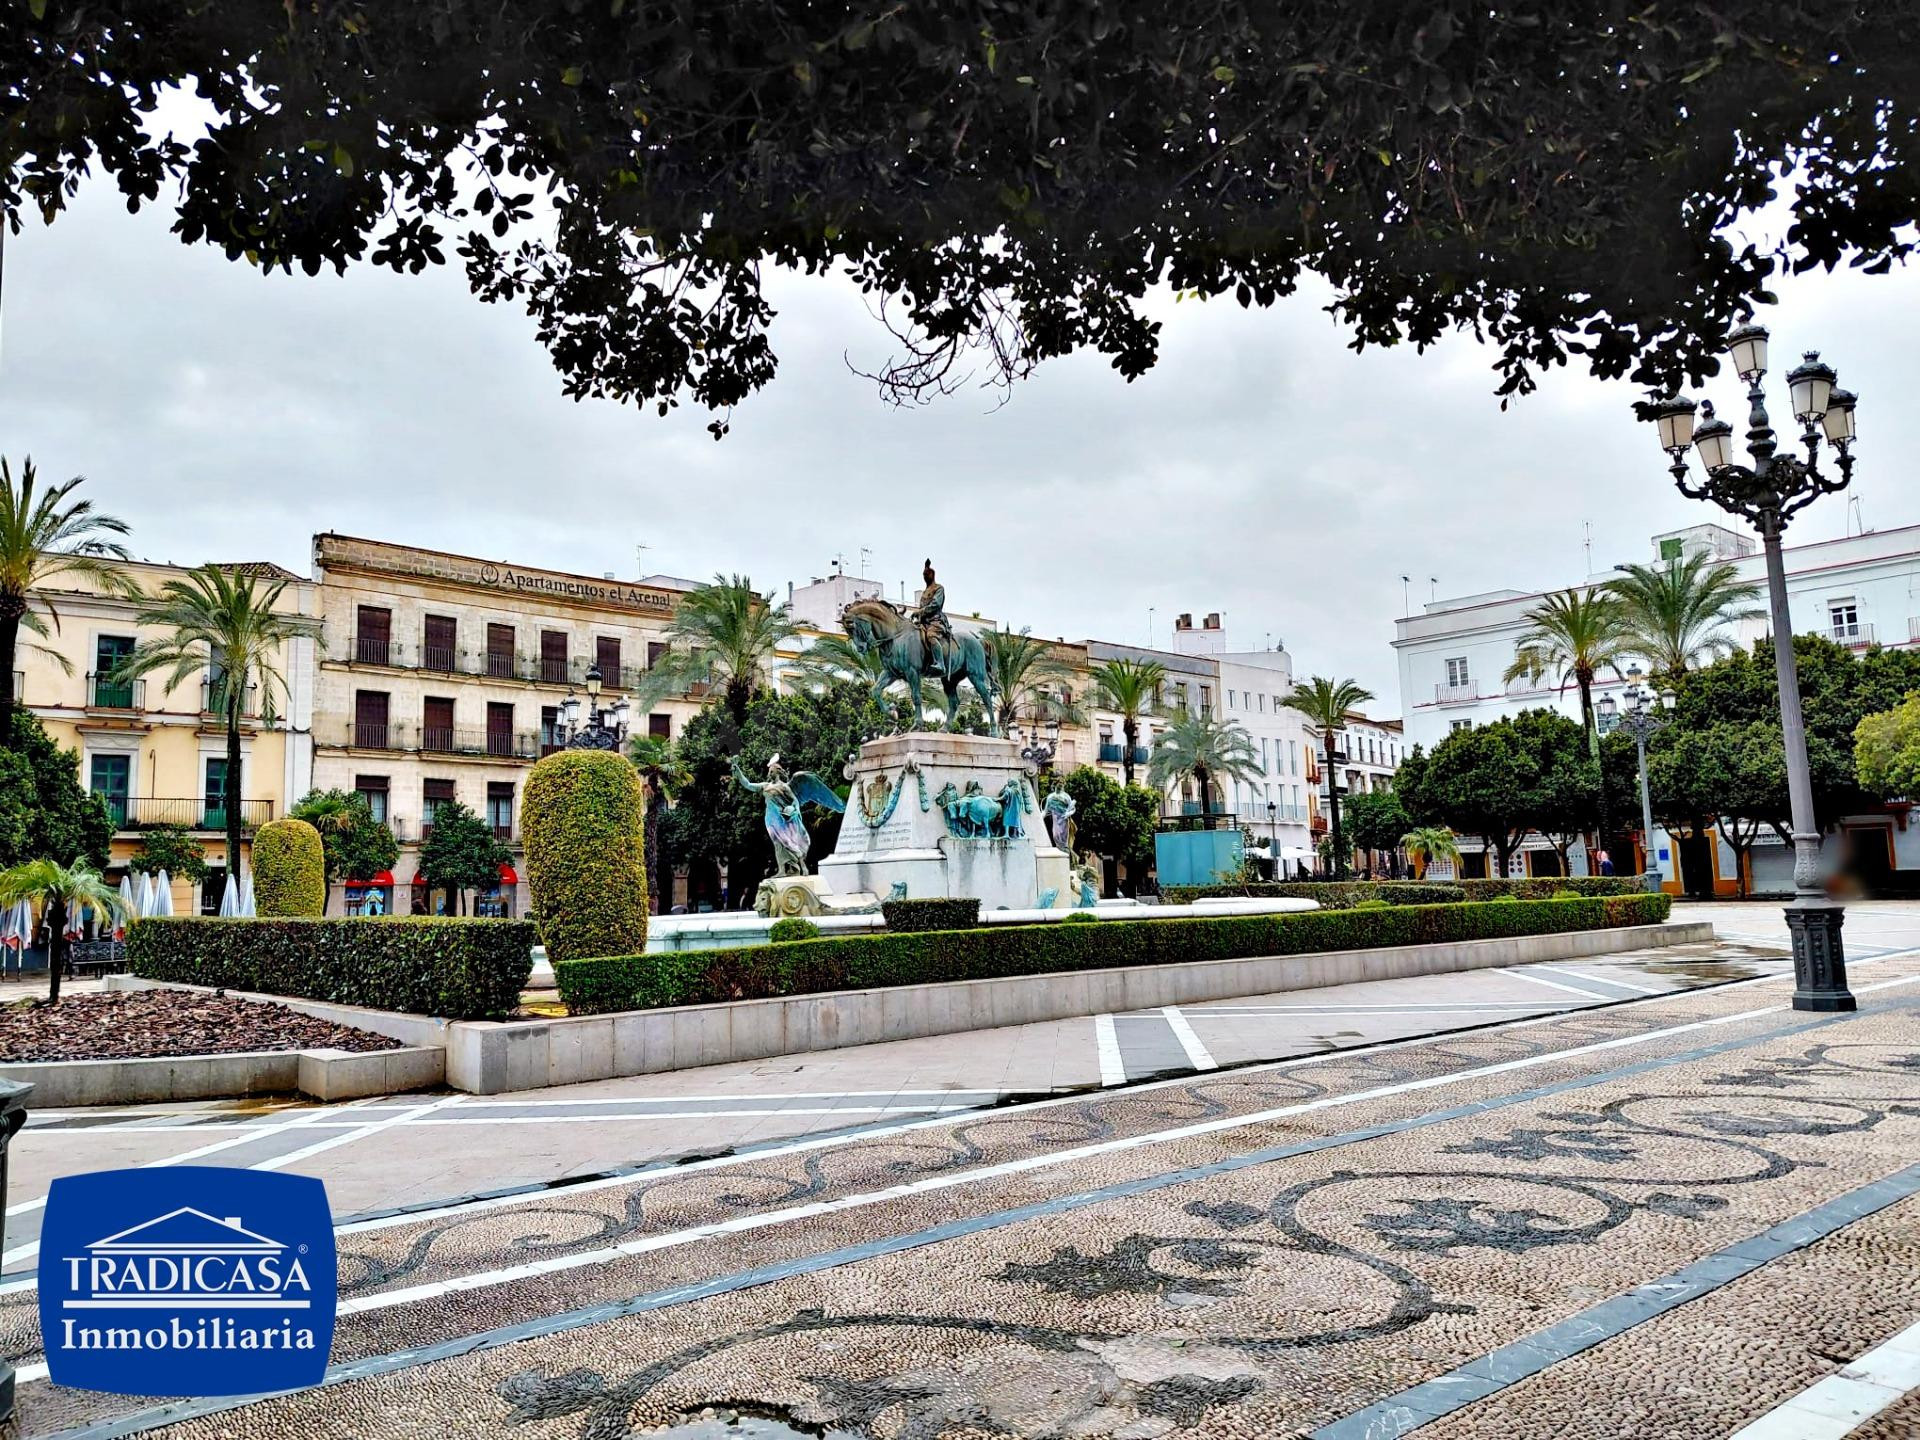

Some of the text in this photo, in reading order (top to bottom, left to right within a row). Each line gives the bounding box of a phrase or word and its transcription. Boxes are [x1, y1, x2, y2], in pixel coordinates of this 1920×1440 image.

[503, 570, 671, 606] Apartamentos el Arenal
